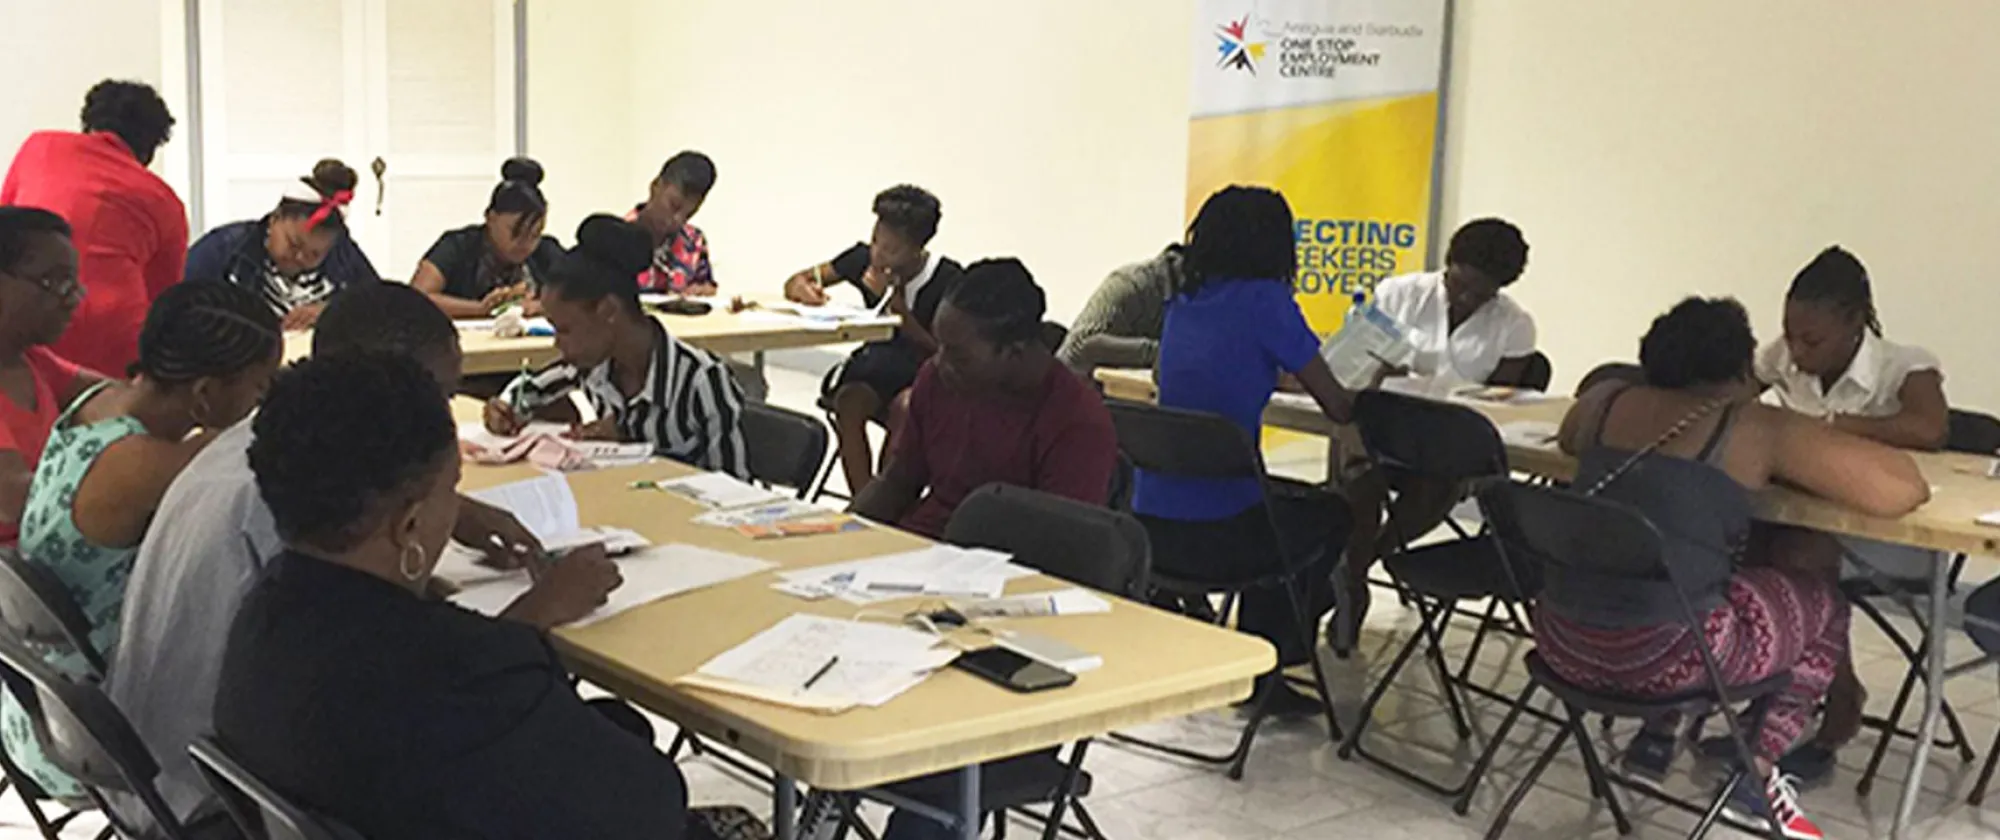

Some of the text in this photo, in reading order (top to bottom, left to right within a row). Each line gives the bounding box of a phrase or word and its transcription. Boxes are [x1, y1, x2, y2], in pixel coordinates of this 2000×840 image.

[1338, 23, 1362, 35] and
[1280, 38, 1355, 52] ONE STOP
[1280, 51, 1380, 66] EMPLOYMENT
[1280, 64, 1335, 78] CENTRE
[1294, 219, 1415, 248] ECTING
[1297, 272, 1390, 295] OYER
